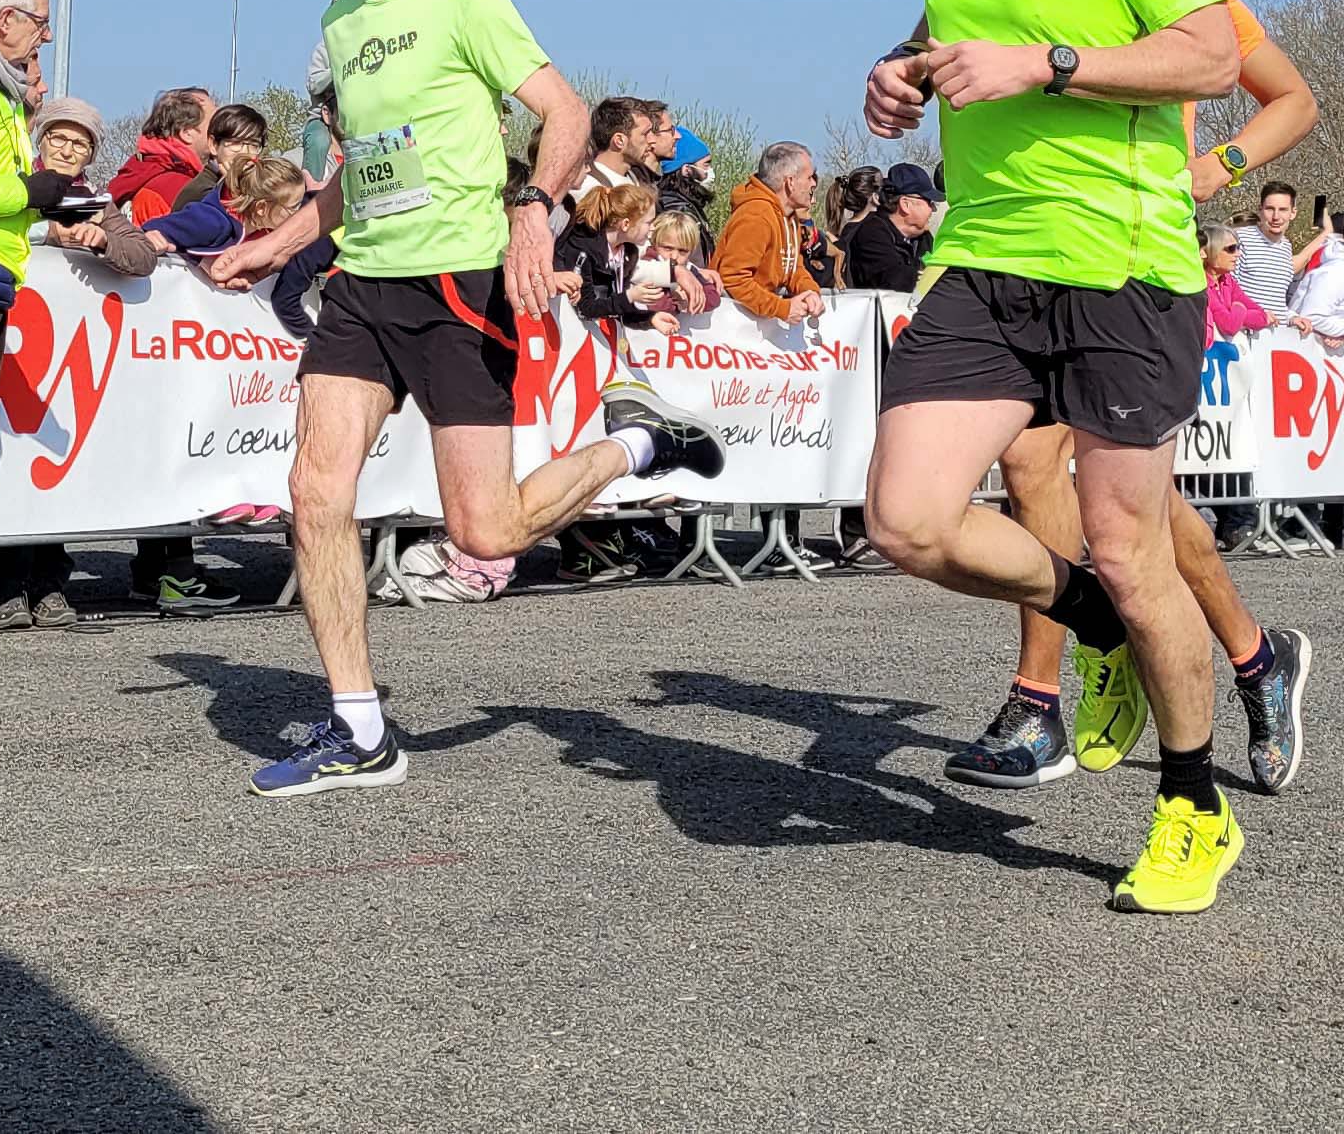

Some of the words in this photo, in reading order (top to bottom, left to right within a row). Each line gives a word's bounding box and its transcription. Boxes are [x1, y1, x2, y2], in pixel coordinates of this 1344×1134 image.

[364, 40, 379, 56] OU
[386, 31, 418, 55] CAP
[361, 48, 384, 70] PAS
[358, 161, 394, 185] 1629
[359, 180, 405, 199] JEAN-MARIE
[172, 320, 306, 361] Roche-
[228, 370, 274, 409] Ville
[279, 381, 299, 403] et
[711, 377, 750, 409] Ville
[755, 383, 773, 405] et
[772, 380, 821, 424] Agglo
[187, 421, 216, 458] Le
[1183, 419, 1233, 462] YON
